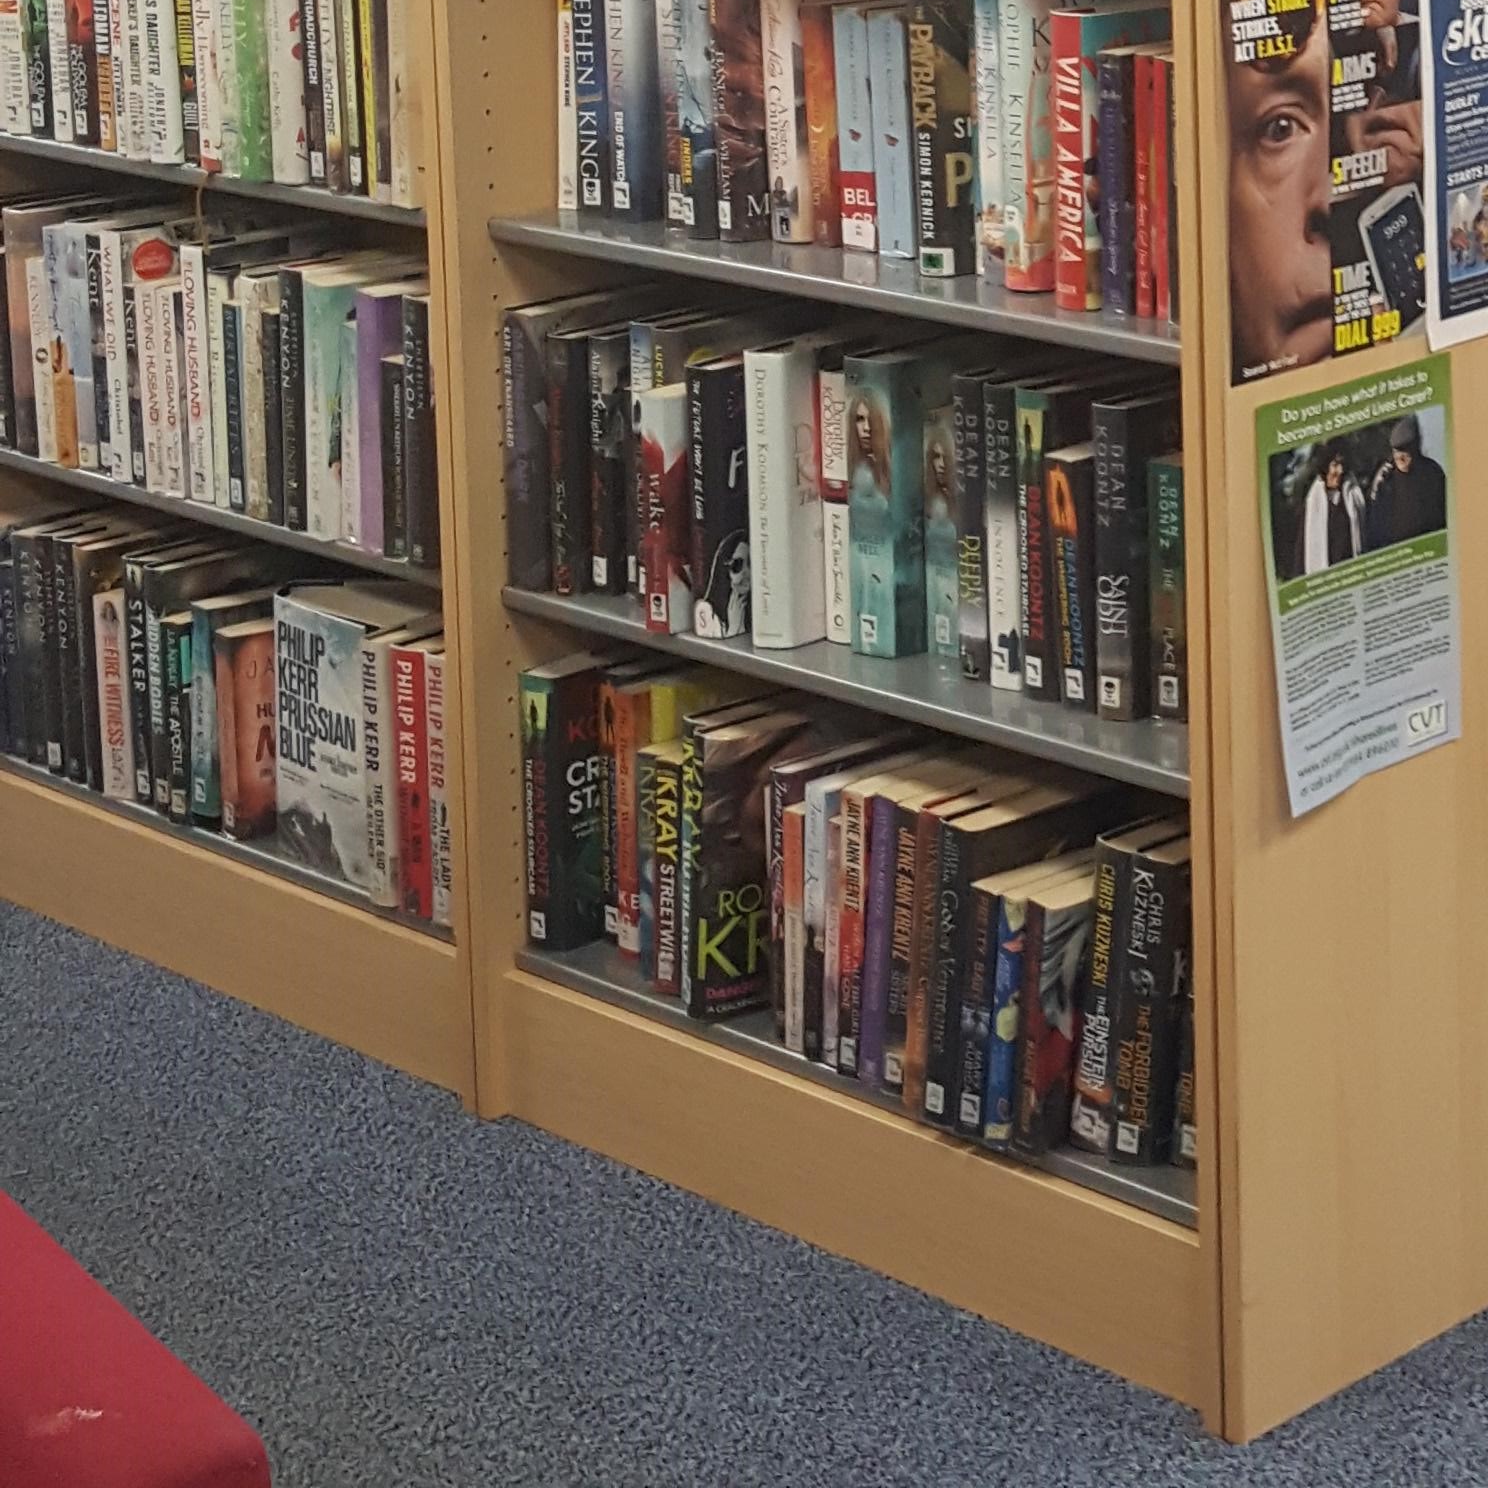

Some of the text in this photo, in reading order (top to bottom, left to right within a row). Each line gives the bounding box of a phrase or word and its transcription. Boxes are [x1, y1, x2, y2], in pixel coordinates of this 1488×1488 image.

[609, 48, 626, 97] KING
[908, 23, 937, 129] PAYBACK
[1234, 41, 1256, 62] ACT
[1332, 52, 1376, 86] ARMS
[183, 102, 199, 131] GUILT
[578, 110, 599, 179] KING
[918, 132, 935, 241] SIMON KERNICK
[1055, 55, 1083, 264] VILLA AMERICA
[1331, 147, 1388, 186] SPEECH
[1447, 164, 1483, 187] STARTS
[87, 247, 100, 305] Kent
[102, 246, 118, 361] WHAT WE DID
[1332, 261, 1371, 294] TIME
[183, 268, 202, 418] LOVING HUSBAND
[1335, 309, 1401, 352] DIAL 999
[1277, 422, 1323, 445] become
[1324, 419, 1333, 431] a
[1333, 407, 1371, 429] Shared
[1371, 398, 1398, 416] Lives
[1281, 408, 1299, 424] Do
[1301, 404, 1322, 422] you
[1323, 395, 1350, 413] have
[1351, 385, 1378, 404] what
[1387, 374, 1415, 393] takes
[1416, 370, 1429, 383] to
[1017, 483, 1030, 637] THE CROOKED STAIRCASE
[1027, 485, 1045, 641] DEAN KOONTZ
[128, 599, 146, 692] STALKER
[277, 620, 325, 668] PHILIP
[278, 657, 319, 705] KERR
[279, 699, 357, 754] PRUSSIAN
[362, 649, 381, 772] PHILIP KERR
[396, 659, 417, 784] PHILIP KERR
[1407, 704, 1444, 734] CVT
[168, 717, 184, 775] APOSTLE
[280, 731, 318, 773] BLUE
[656, 775, 677, 862] KRAY
[1091, 862, 1116, 989] CHRIS KUZNESKI
[1127, 867, 1165, 960] CHRIS KUZNESKI
[1117, 1038, 1136, 1090] TOMB
